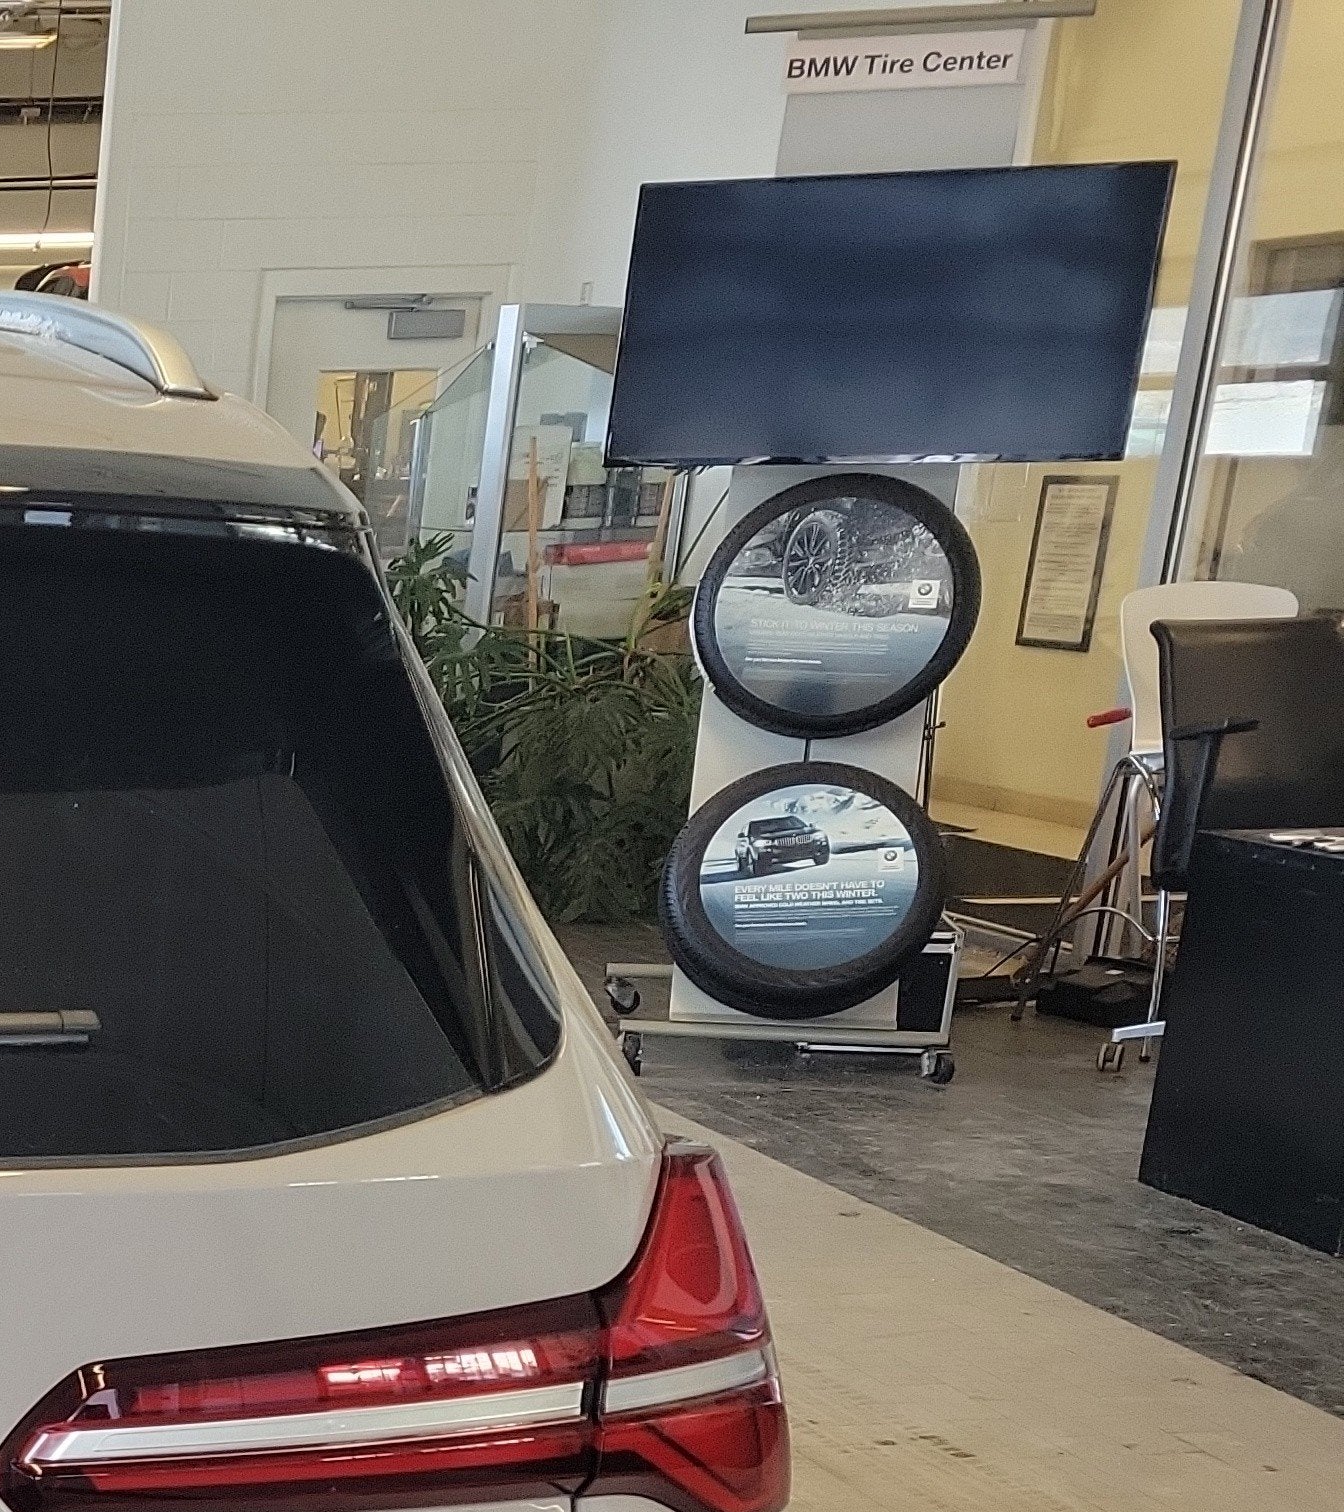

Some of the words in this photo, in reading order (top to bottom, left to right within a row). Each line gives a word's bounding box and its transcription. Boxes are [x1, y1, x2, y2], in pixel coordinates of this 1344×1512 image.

[787, 55, 858, 79] BMW
[865, 53, 913, 75] Tire
[922, 50, 1013, 73] Center
[735, 885, 766, 894] EVERY
[769, 883, 792, 892] MILE
[794, 881, 838, 891] DOESN'T
[840, 880, 869, 889] HAVE
[870, 880, 885, 888] TO
[735, 893, 760, 901] FEEL
[761, 892, 783, 900] LIKE
[784, 891, 809, 900] TWO
[811, 890, 834, 899] THIS
